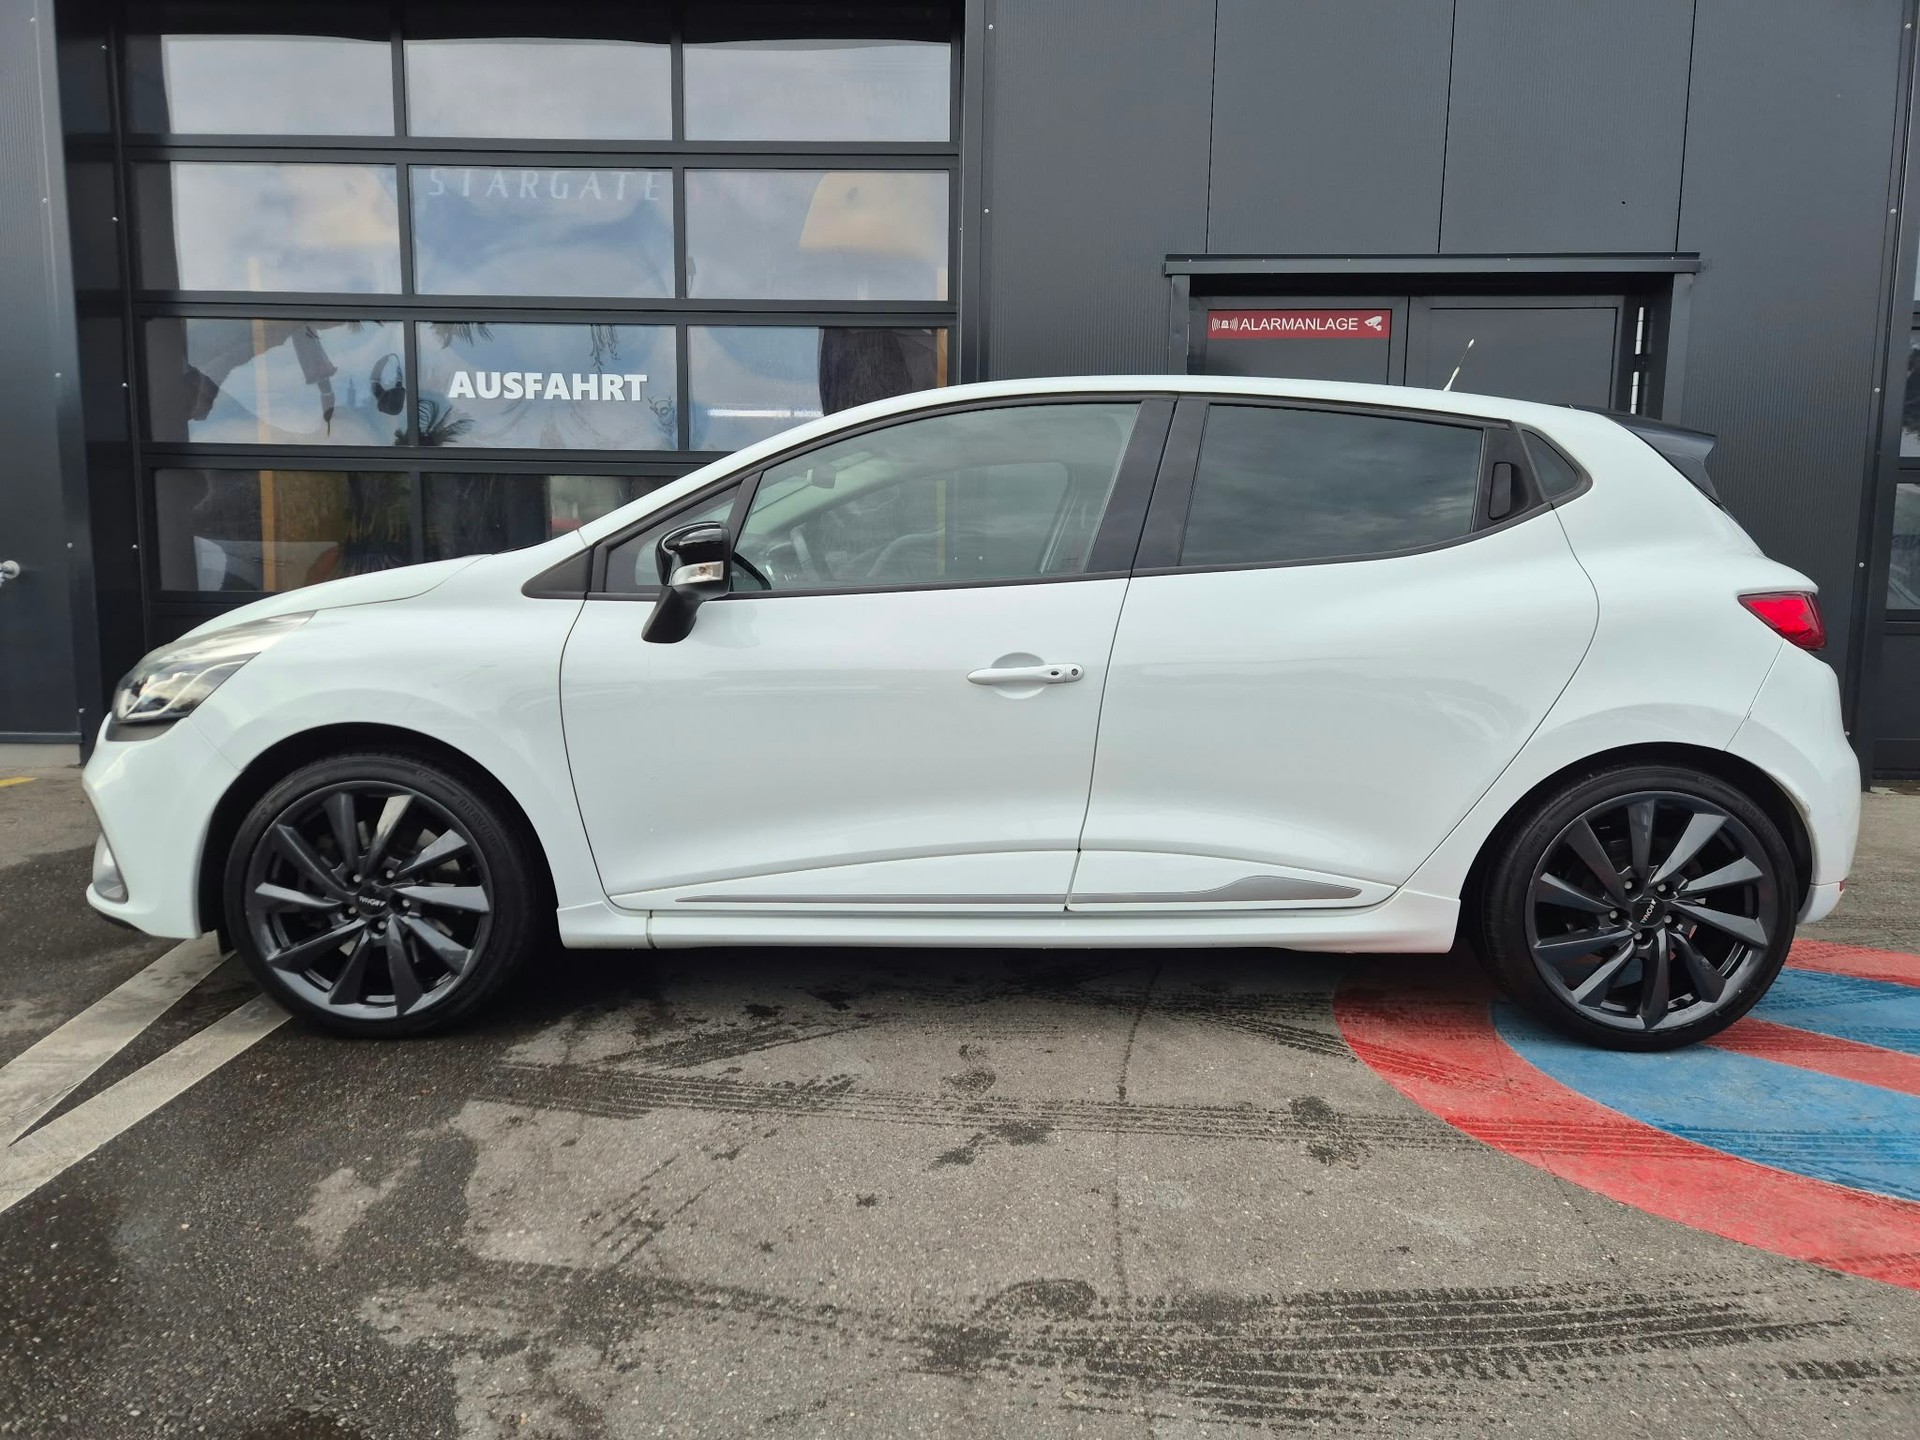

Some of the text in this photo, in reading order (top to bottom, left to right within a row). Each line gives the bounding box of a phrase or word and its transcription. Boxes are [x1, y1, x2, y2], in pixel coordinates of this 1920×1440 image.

[428, 169, 661, 201] STARGATE
[1240, 317, 1358, 331] ALARMANLAGE
[448, 371, 648, 401] AUSFAHRT
